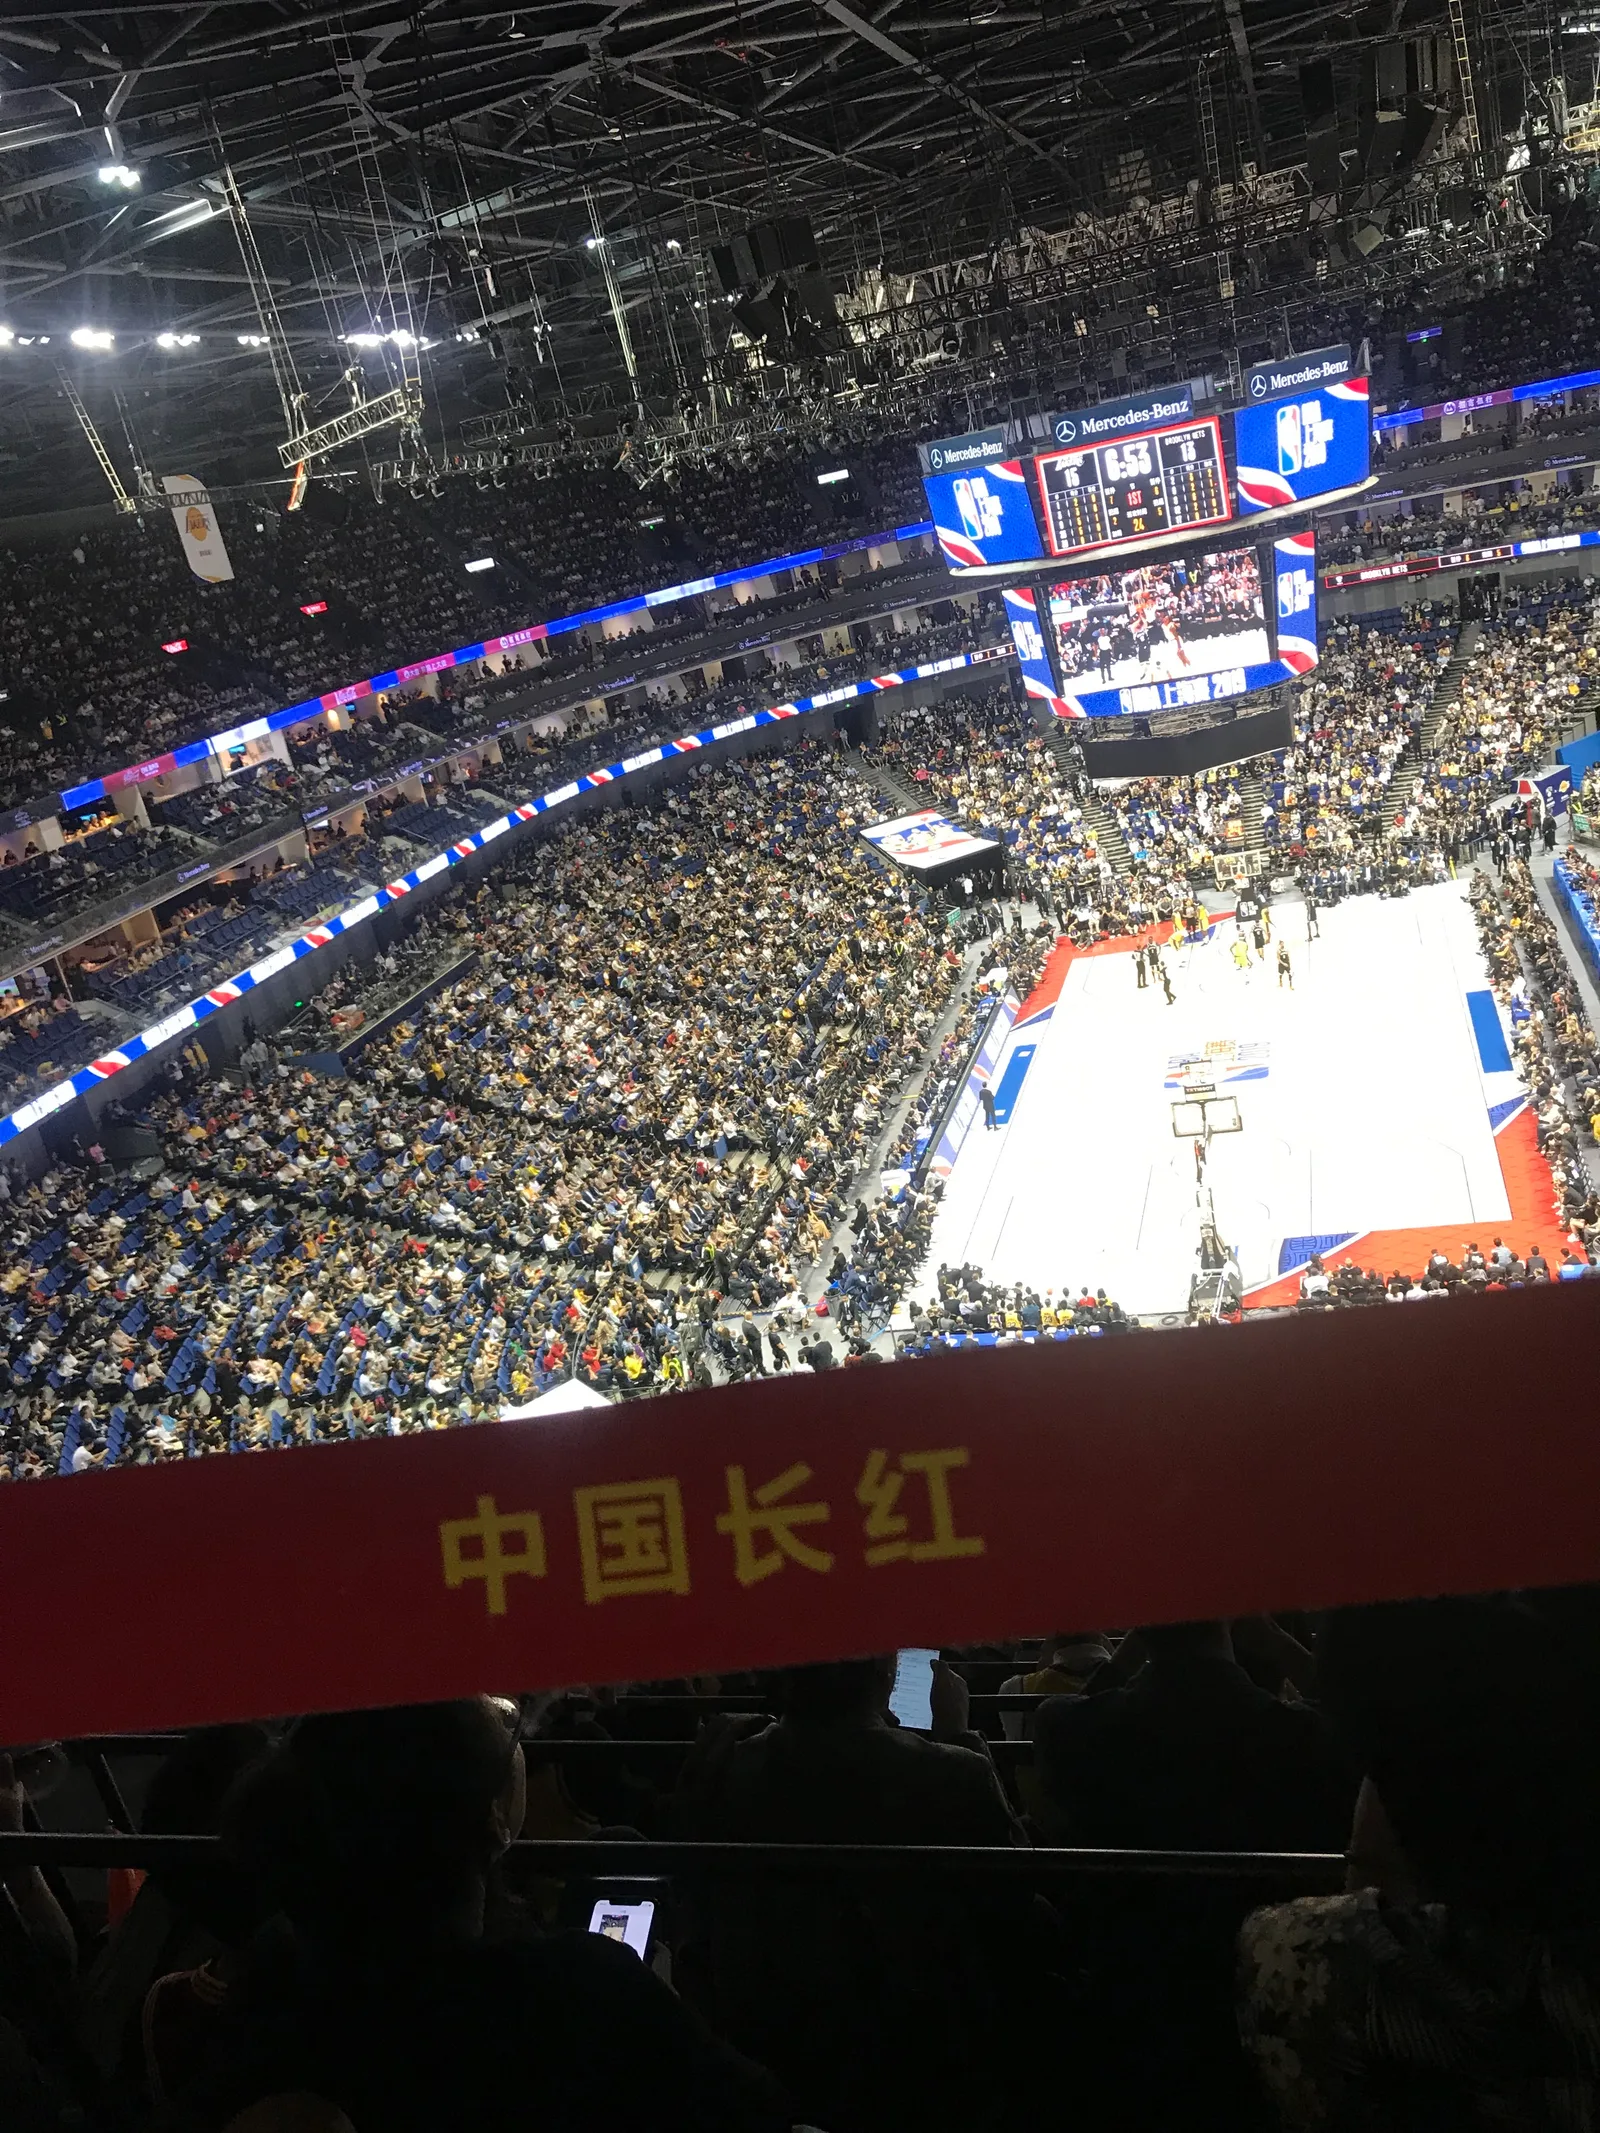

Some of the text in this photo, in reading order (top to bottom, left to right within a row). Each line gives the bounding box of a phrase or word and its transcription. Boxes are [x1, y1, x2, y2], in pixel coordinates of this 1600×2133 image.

[1270, 360, 1349, 390] Mercedes-Benz
[1081, 400, 1189, 435] Mercedes-Benz
[943, 442, 1004, 464] Mercedes-Benz
[1104, 440, 1153, 482] 6:53
[1180, 440, 1197, 462] 13
[1064, 467, 1080, 488] 15
[1127, 490, 1142, 506] 1ST
[1132, 517, 1145, 532] 24
[438, 1447, 986, 1616] 中国长红
